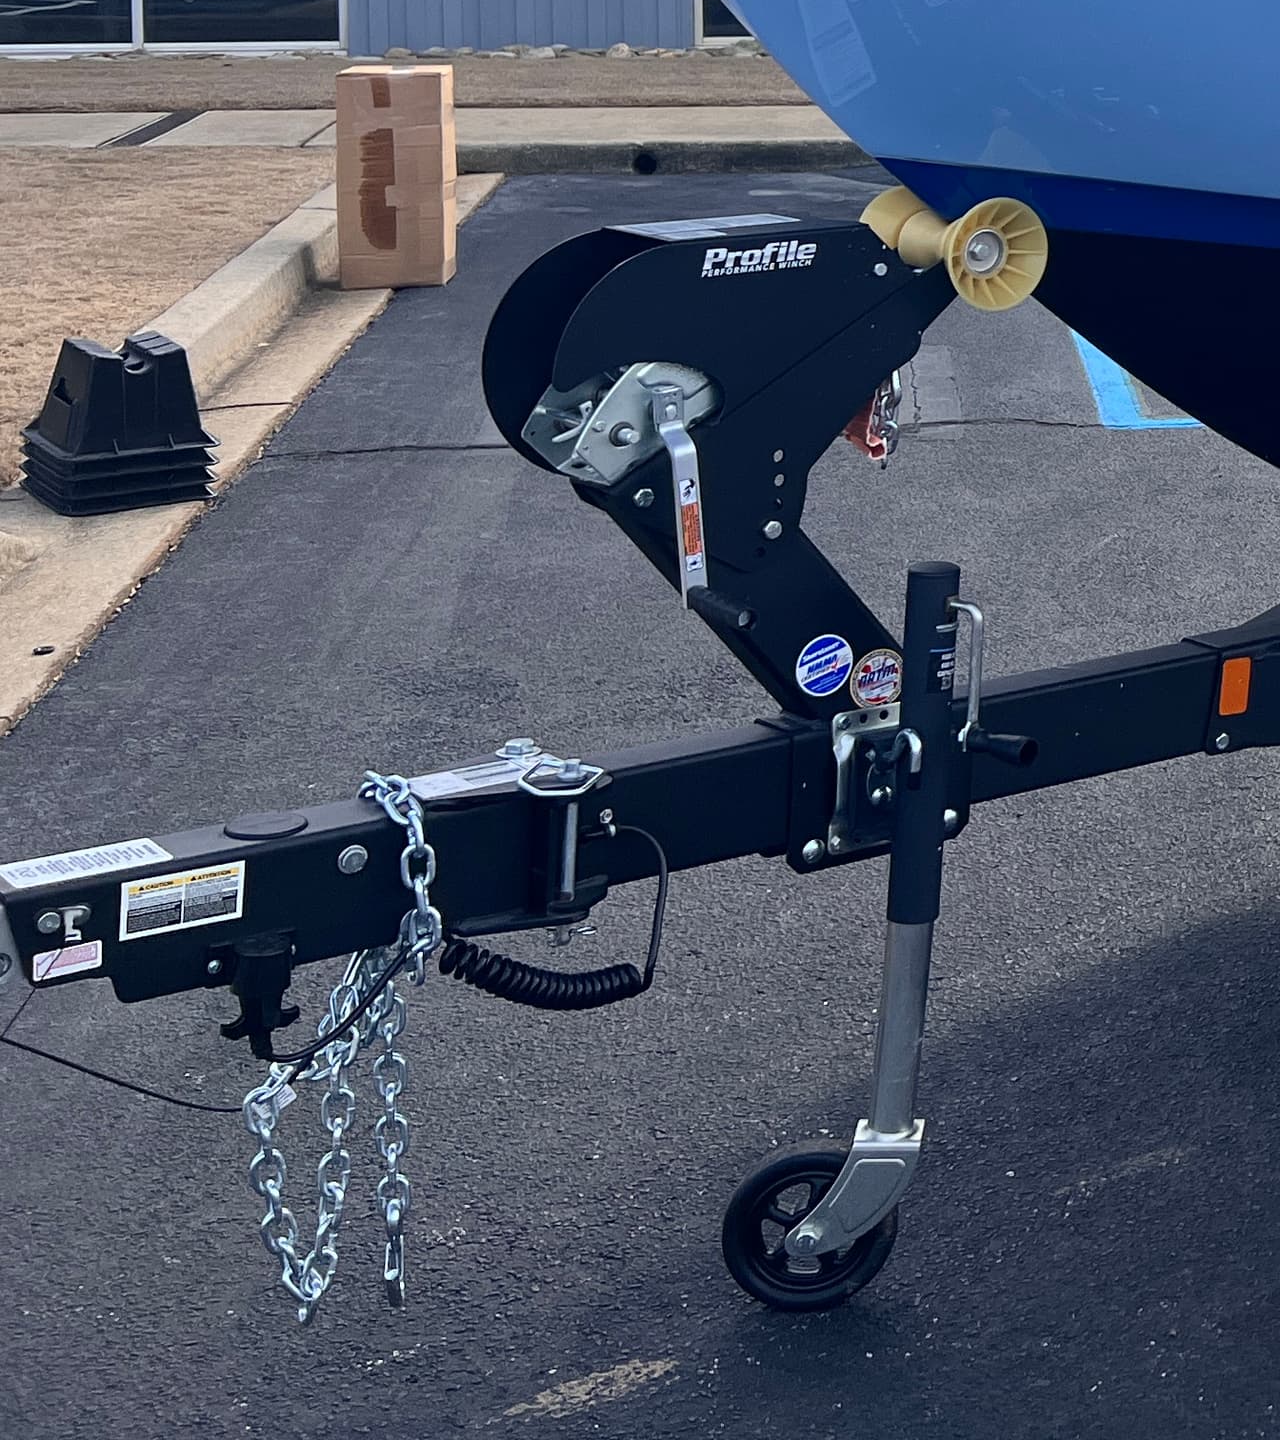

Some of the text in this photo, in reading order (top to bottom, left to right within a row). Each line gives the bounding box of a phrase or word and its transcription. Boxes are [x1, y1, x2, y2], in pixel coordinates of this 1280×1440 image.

[702, 240, 817, 270] Profile
[701, 260, 812, 278] PERFORMANCE WINCH
[145, 881, 174, 890] CAUTION
